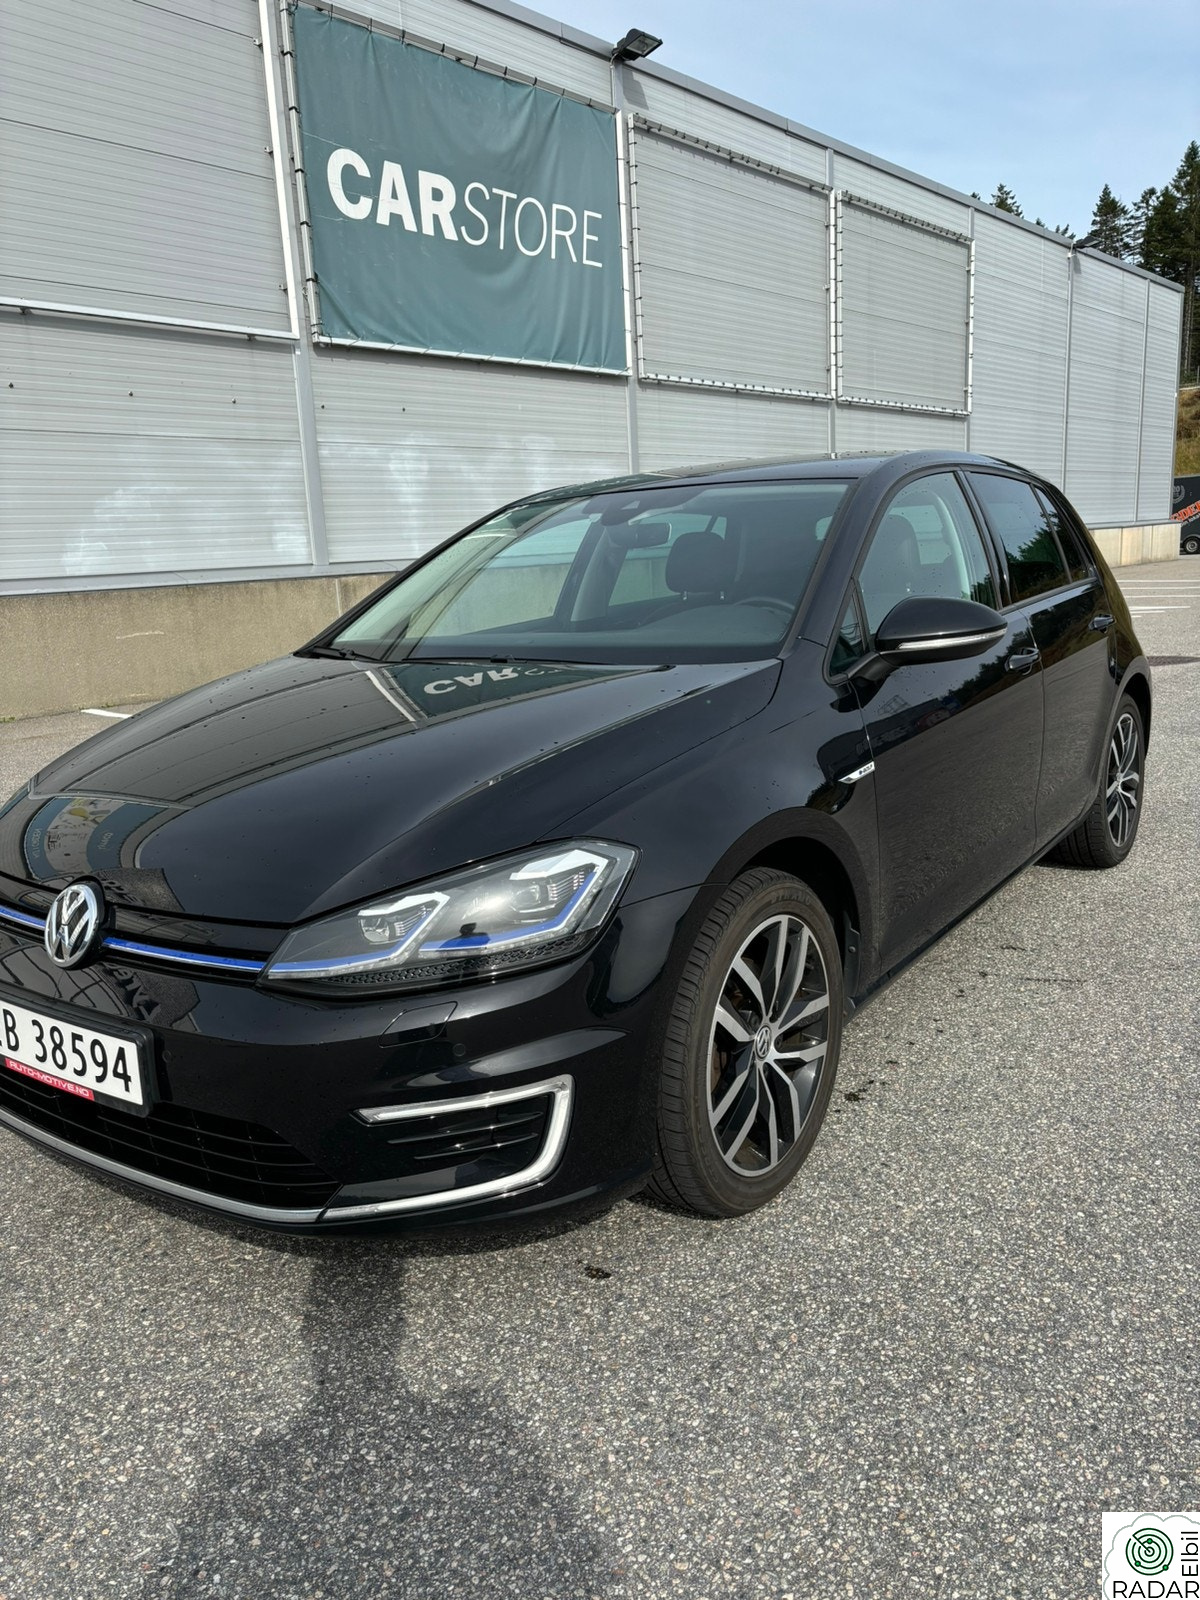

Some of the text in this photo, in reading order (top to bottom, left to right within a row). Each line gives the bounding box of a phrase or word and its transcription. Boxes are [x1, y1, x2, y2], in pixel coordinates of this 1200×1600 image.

[327, 148, 603, 268] CARSTORE
[0, 1008, 132, 1093] B 38594
